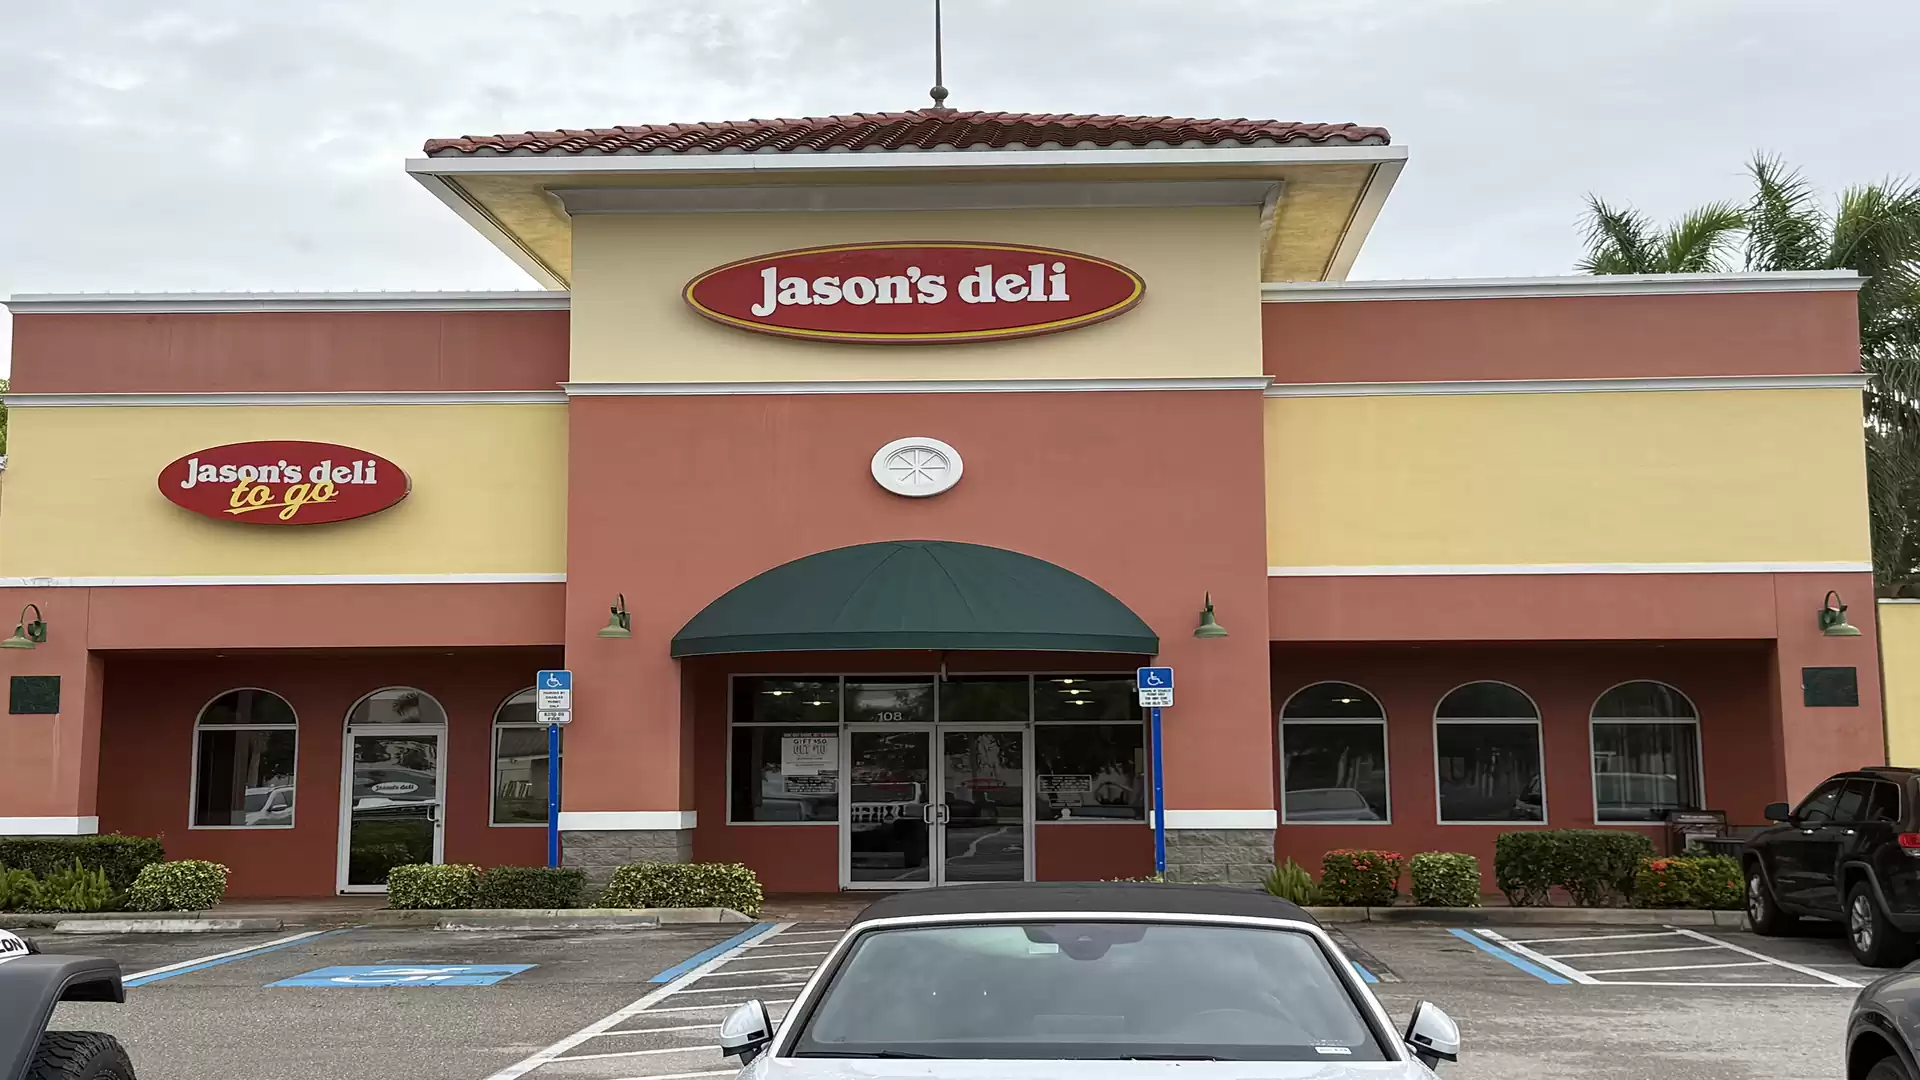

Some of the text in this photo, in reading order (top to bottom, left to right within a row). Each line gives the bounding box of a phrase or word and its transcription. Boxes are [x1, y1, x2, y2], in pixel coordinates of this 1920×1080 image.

[751, 262, 1070, 317] Jason's deli
[180, 458, 377, 489] Jason's deli
[229, 477, 339, 520] to go
[877, 711, 902, 721] 108
